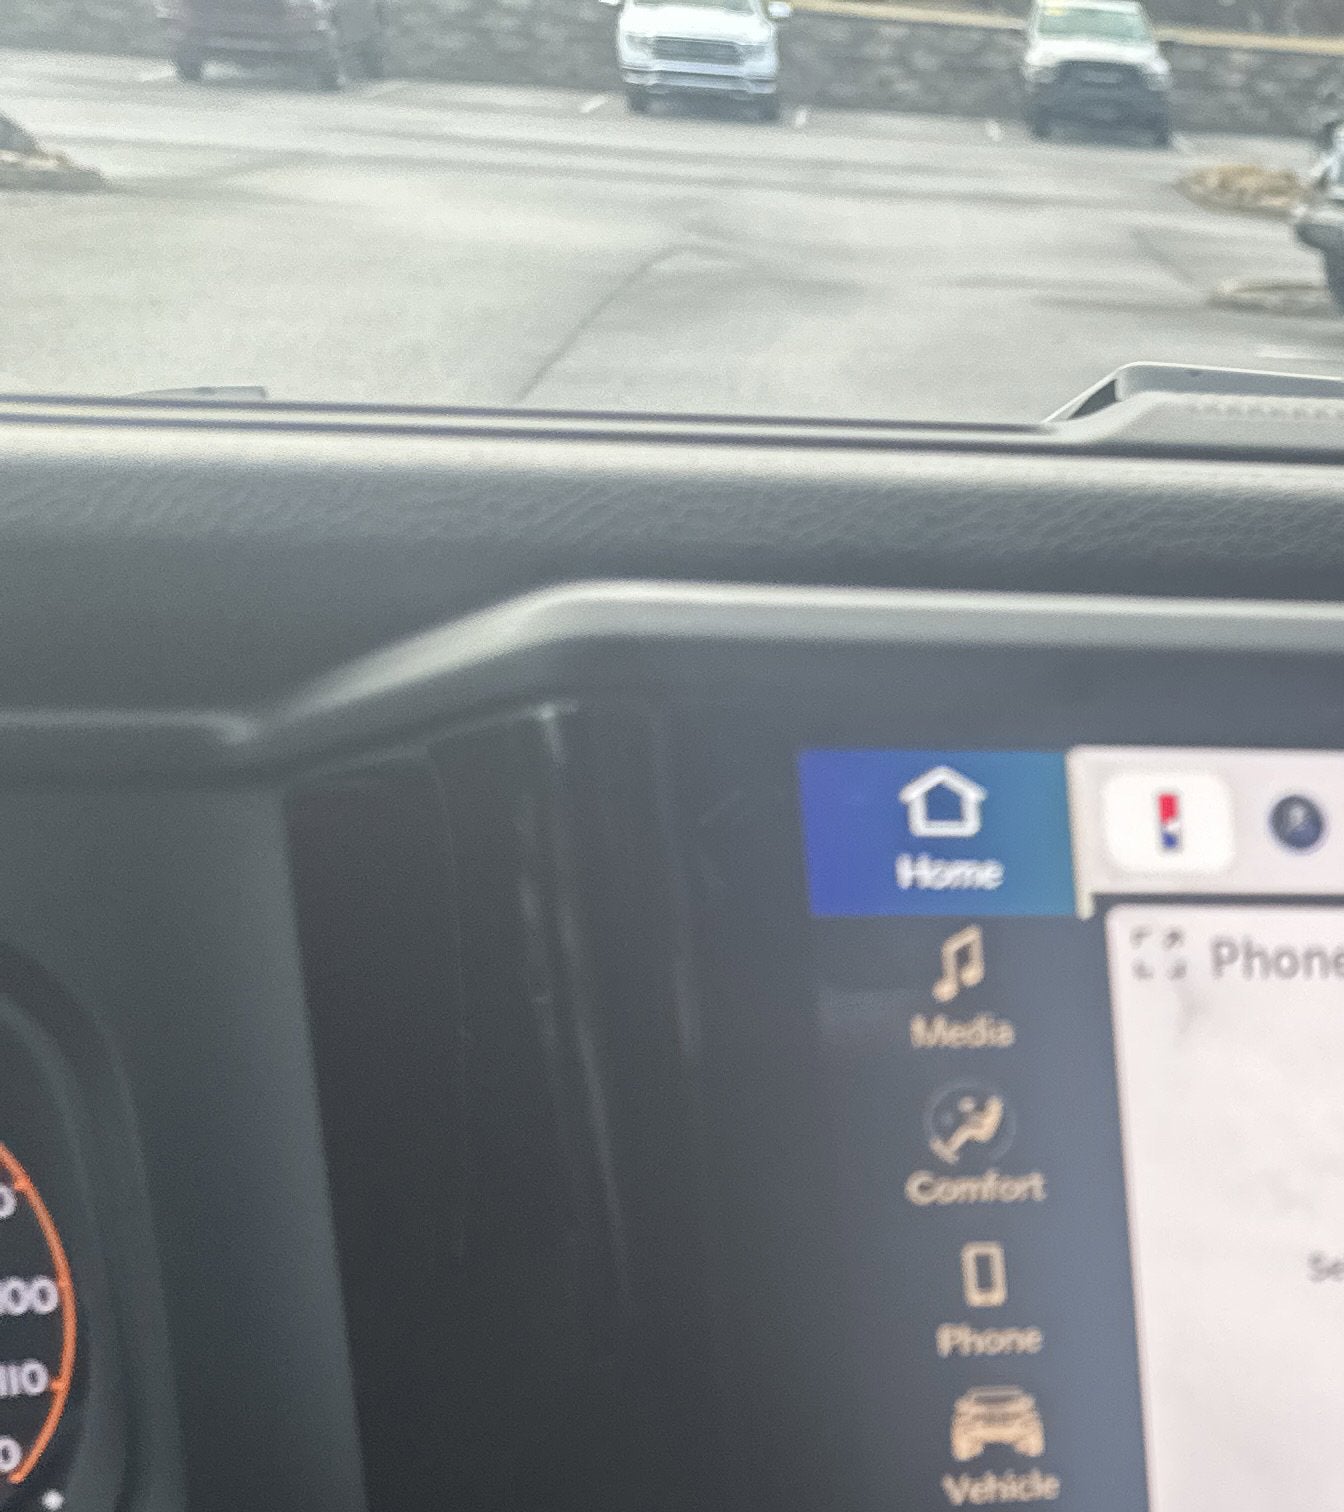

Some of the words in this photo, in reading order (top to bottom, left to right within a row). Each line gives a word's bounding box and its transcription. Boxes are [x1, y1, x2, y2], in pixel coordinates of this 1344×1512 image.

[896, 854, 1005, 892] Home
[910, 1016, 1015, 1050] Media
[905, 1172, 1048, 1206] Comfort
[936, 1323, 1043, 1357] Phone
[941, 1470, 1061, 1505] Vehicle
